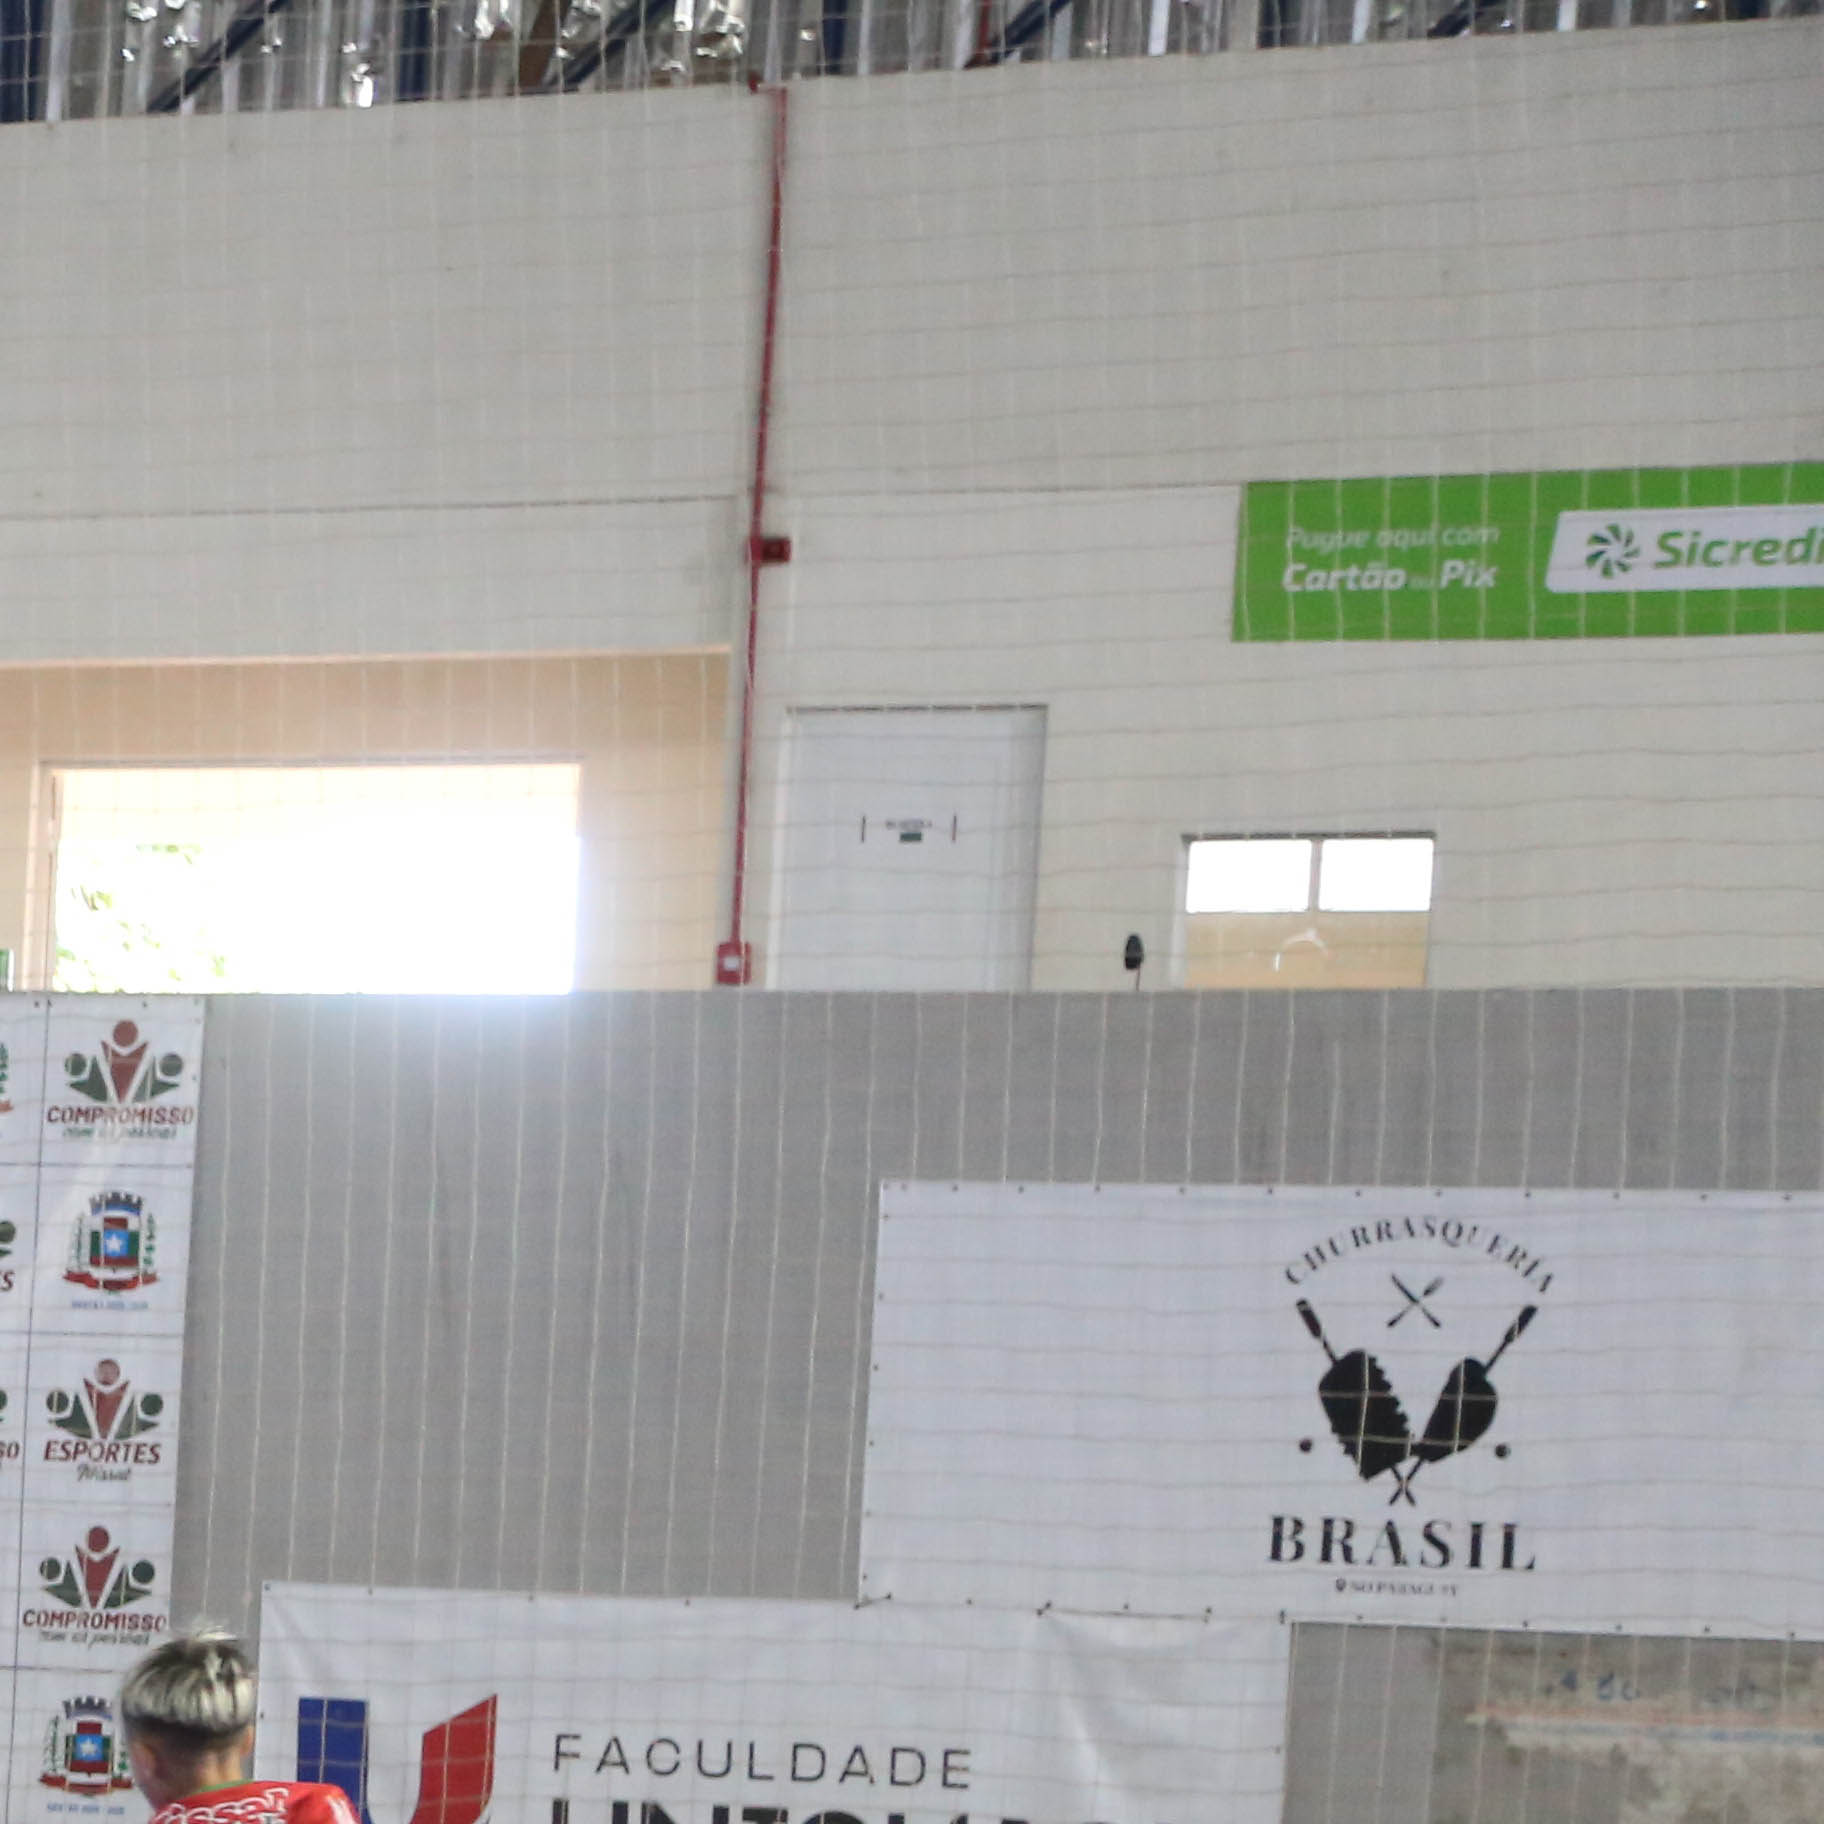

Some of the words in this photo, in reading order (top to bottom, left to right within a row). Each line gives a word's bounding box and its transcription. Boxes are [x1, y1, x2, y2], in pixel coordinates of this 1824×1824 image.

[1282, 561, 1407, 592] Cartão
[1440, 559, 1498, 588] Pix
[46, 1105, 194, 1127] COMPROMISSO
[43, 1440, 162, 1466] ESPORTES
[1269, 1514, 1537, 1571] BRASIL
[23, 1608, 167, 1633] COMPROMISSO
[554, 1732, 972, 1791] FACULDADE
